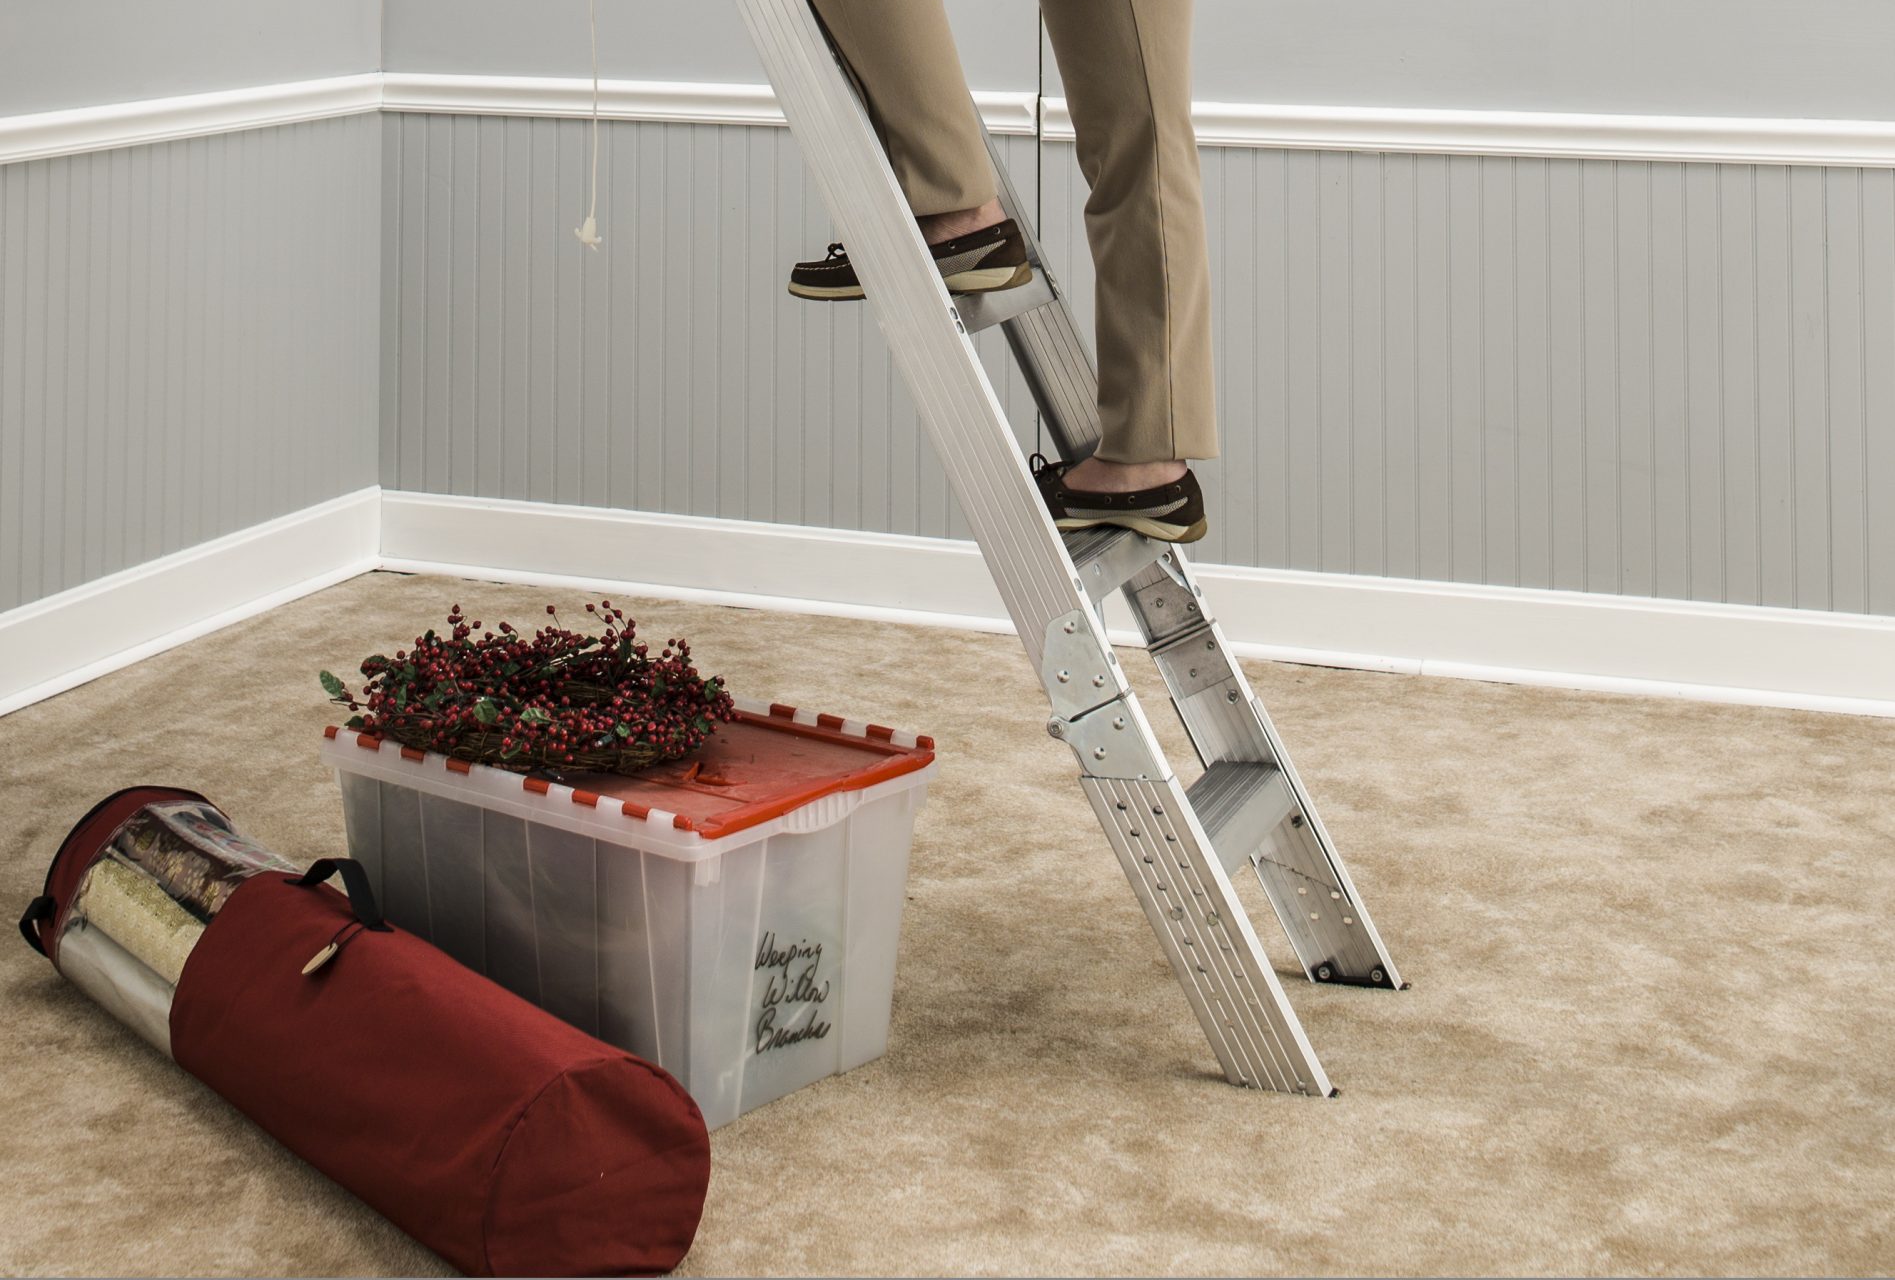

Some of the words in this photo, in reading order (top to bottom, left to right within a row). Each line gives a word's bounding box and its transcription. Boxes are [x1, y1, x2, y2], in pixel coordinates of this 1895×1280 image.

[755, 931, 822, 977] Weeping
[763, 965, 830, 1008] Willow
[756, 1008, 831, 1054] Branches
